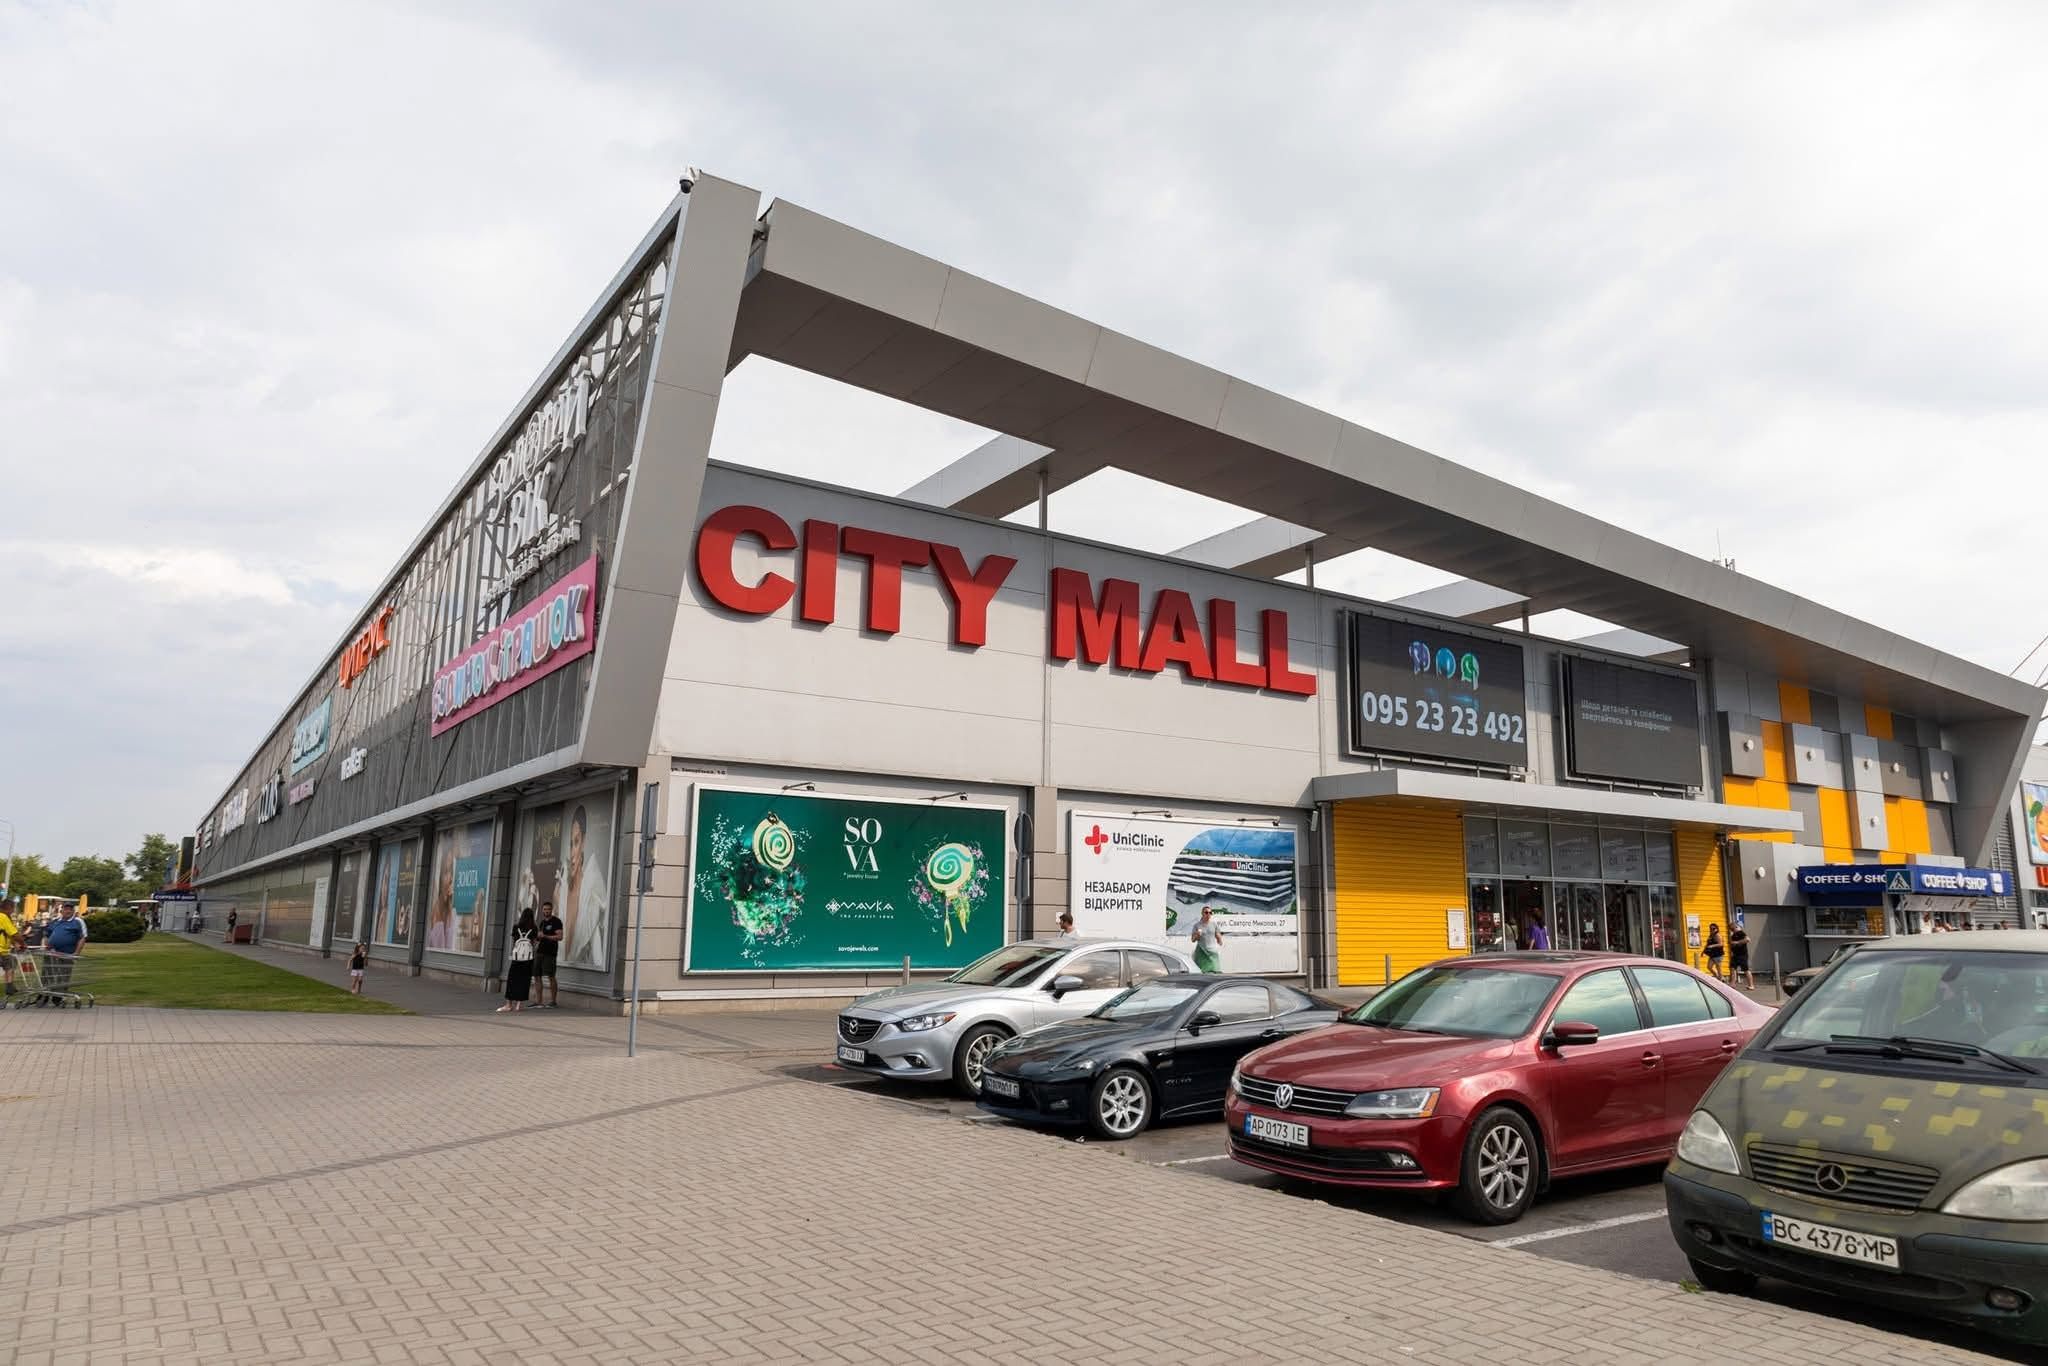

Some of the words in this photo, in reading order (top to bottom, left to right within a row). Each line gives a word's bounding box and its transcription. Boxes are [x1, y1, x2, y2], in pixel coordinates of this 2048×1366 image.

[696, 505, 1017, 646] CITY
[1051, 567, 1316, 696] MALL
[1362, 691, 1408, 727] 095
[1416, 700, 1444, 731] 23
[1451, 705, 1478, 736] 23
[1484, 712, 1524, 743] 492
[844, 816, 882, 844] SO
[1113, 832, 1164, 847] UniClinic
[843, 844, 881, 872] VA
[1236, 861, 1269, 872] UniClinic
[1085, 881, 1151, 894] НЕЗАБАРОМ
[1804, 875, 1851, 884] COFFEE
[1864, 874, 1887, 883] SHO
[1922, 874, 1958, 888] COFFEE
[1964, 877, 1987, 890] SHOP
[1085, 898, 1143, 911] ВІДКРИТТЯ
[1252, 1118, 1265, 1133] AP
[1265, 1121, 1288, 1138] 0173
[1292, 1126, 1305, 1142] IE
[1773, 1219, 1801, 1242] BC
[1807, 1228, 1857, 1255] 4378
[1862, 1238, 1895, 1261] MP
